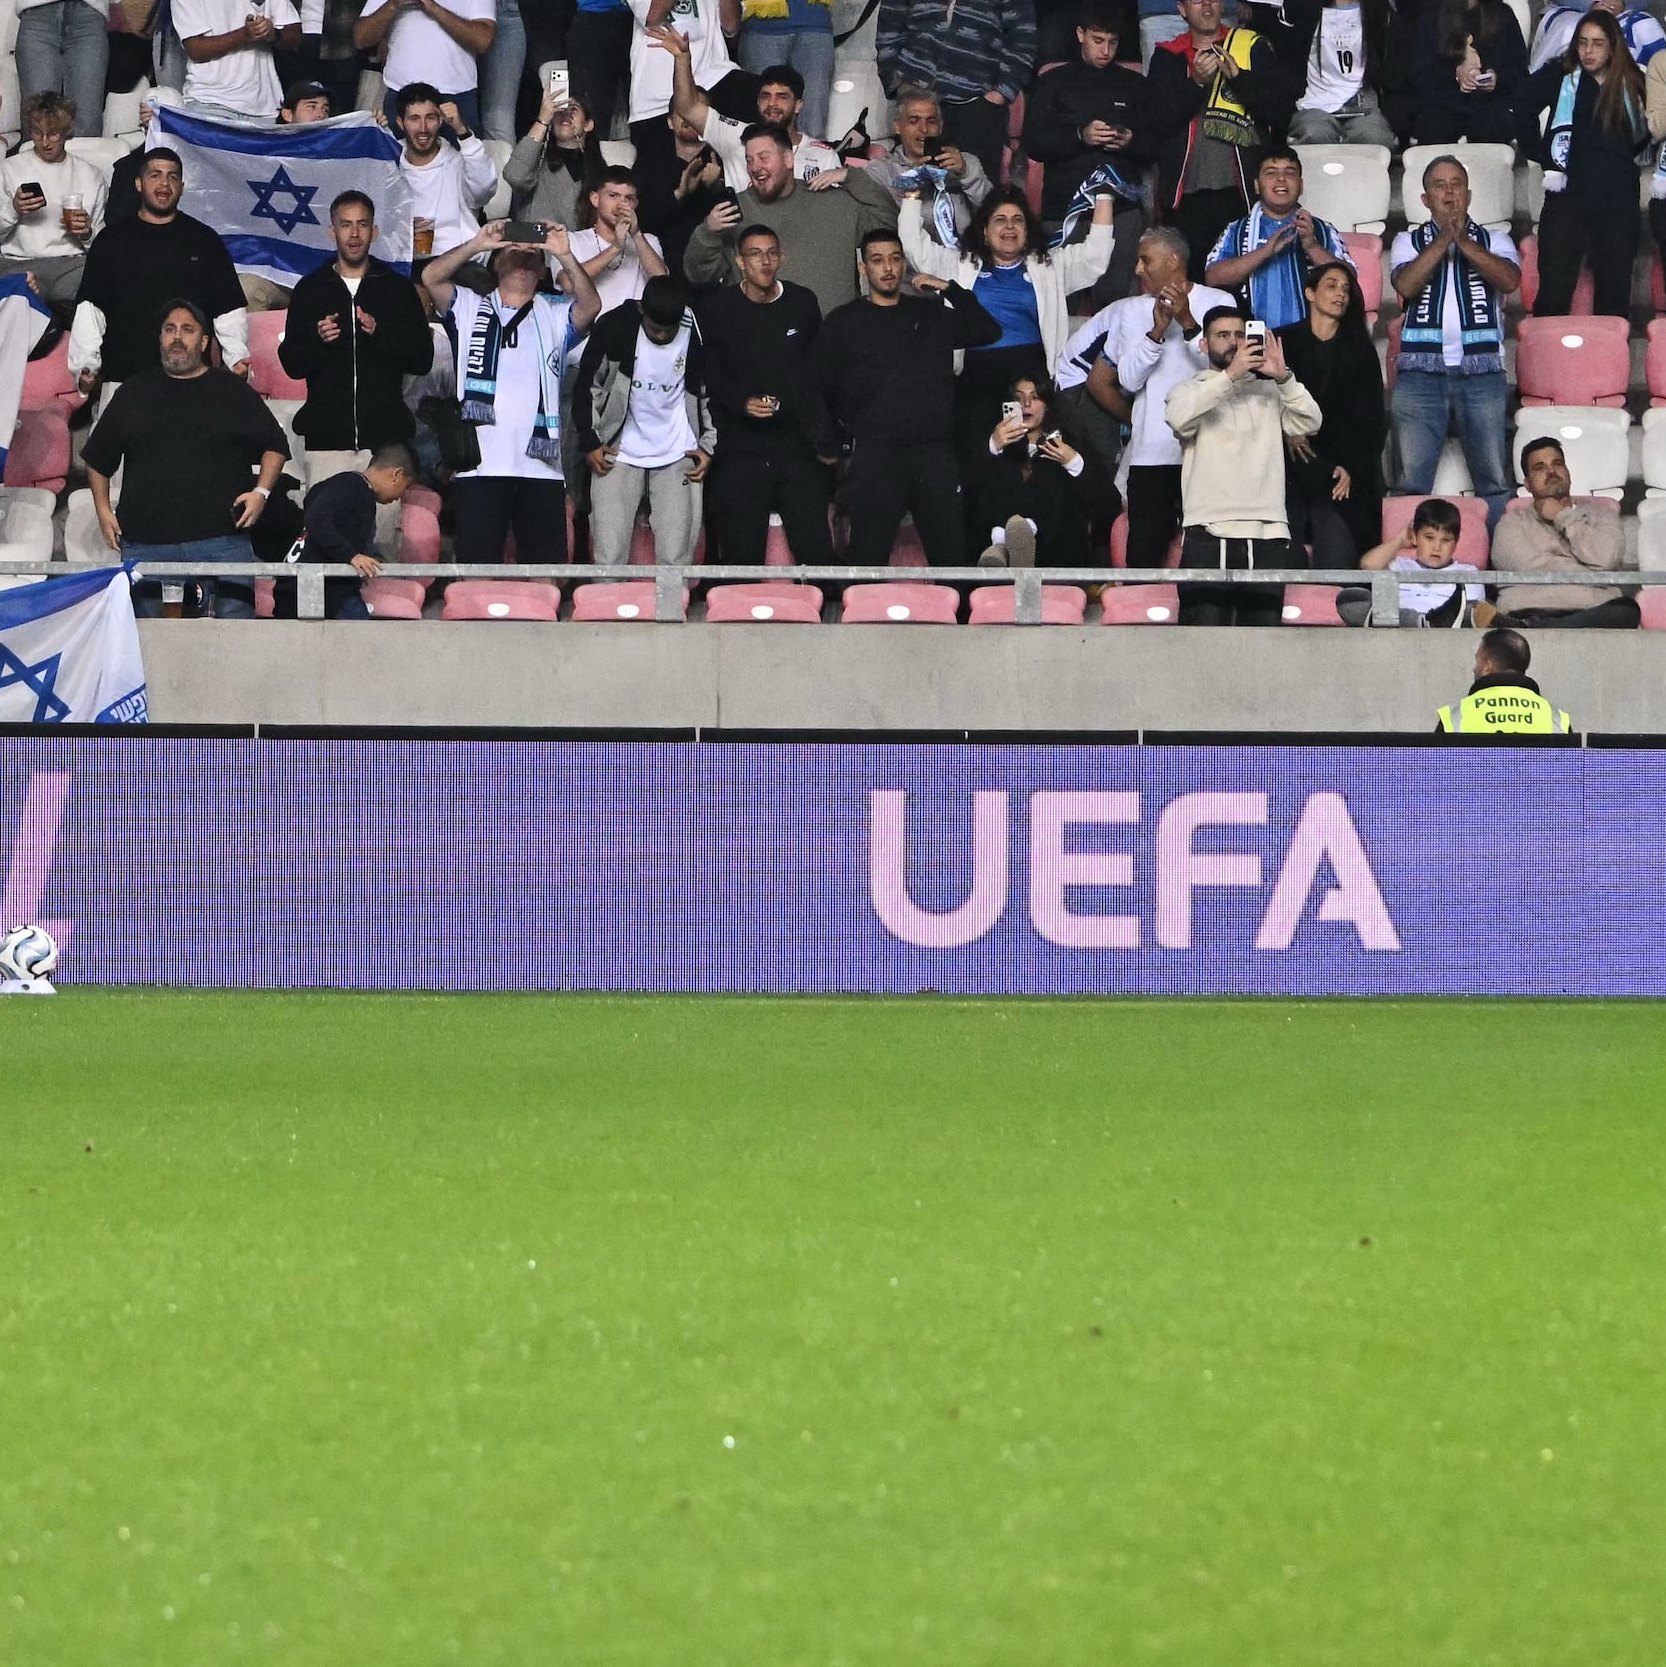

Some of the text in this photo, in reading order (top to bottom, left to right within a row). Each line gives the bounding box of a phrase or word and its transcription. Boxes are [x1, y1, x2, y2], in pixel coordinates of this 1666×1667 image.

[1336, 50, 1354, 74] 19
[1475, 697, 1540, 710] Pannon
[1485, 711, 1533, 725] Guard
[870, 788, 1400, 953] UEFA
